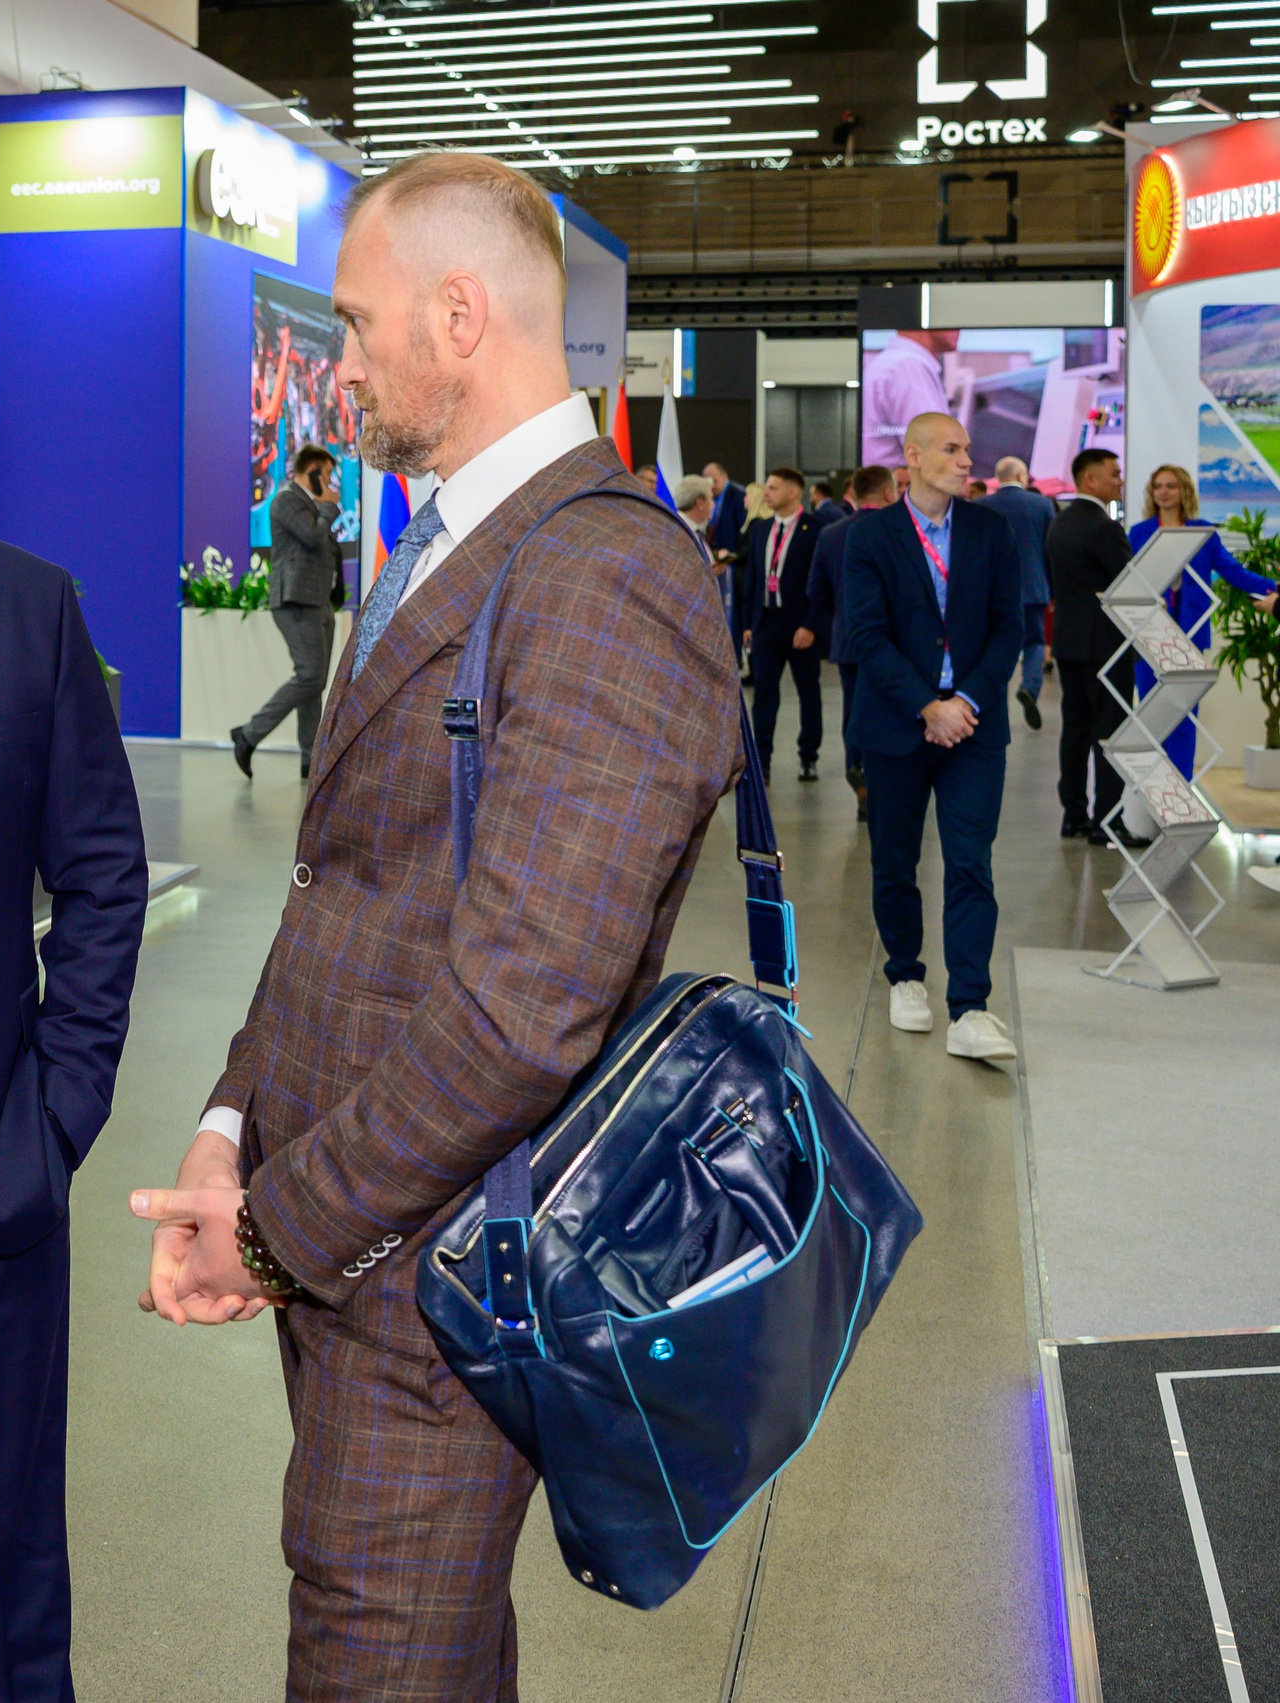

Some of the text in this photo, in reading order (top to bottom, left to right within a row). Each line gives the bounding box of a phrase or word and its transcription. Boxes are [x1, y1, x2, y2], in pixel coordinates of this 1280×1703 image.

[917, 116, 1047, 146] Ростех
[10, 176, 161, 196] eec.eaeunion.org
[1186, 179, 1280, 230] КЫРГЫЗС
